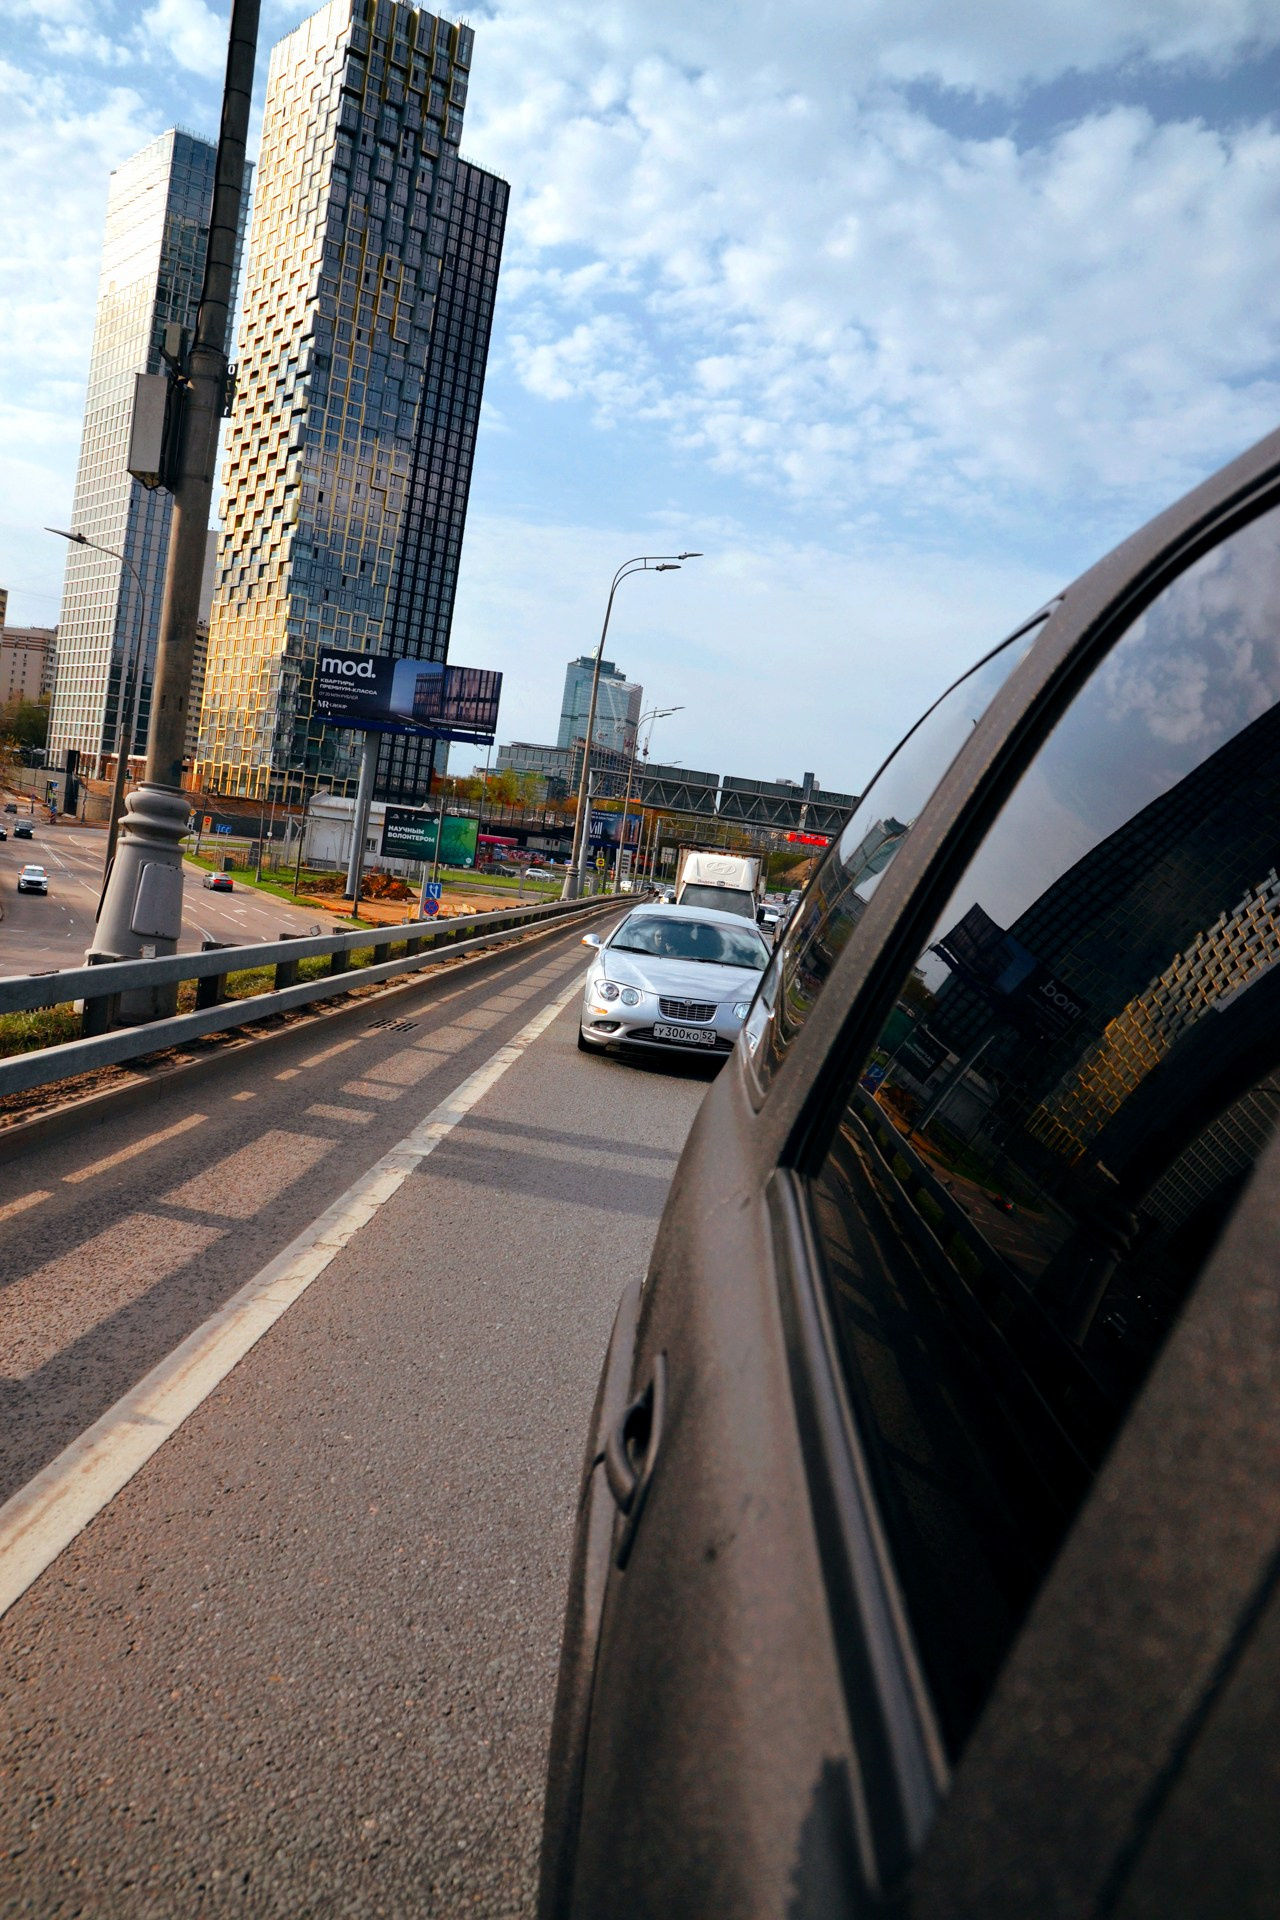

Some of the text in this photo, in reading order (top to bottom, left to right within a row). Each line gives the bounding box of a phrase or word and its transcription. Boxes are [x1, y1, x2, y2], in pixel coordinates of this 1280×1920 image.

[321, 657, 377, 678] mod.
[320, 678, 355, 687] КВАРТИРЫ
[319, 683, 378, 696] ПРЕМИУМ-КЛАССА
[318, 699, 329, 709] MR
[388, 825, 425, 835] НАУЧНЫМ
[387, 832, 435, 843] ВОЛОНТЕРОМ
[702, 1032, 713, 1041] 52
